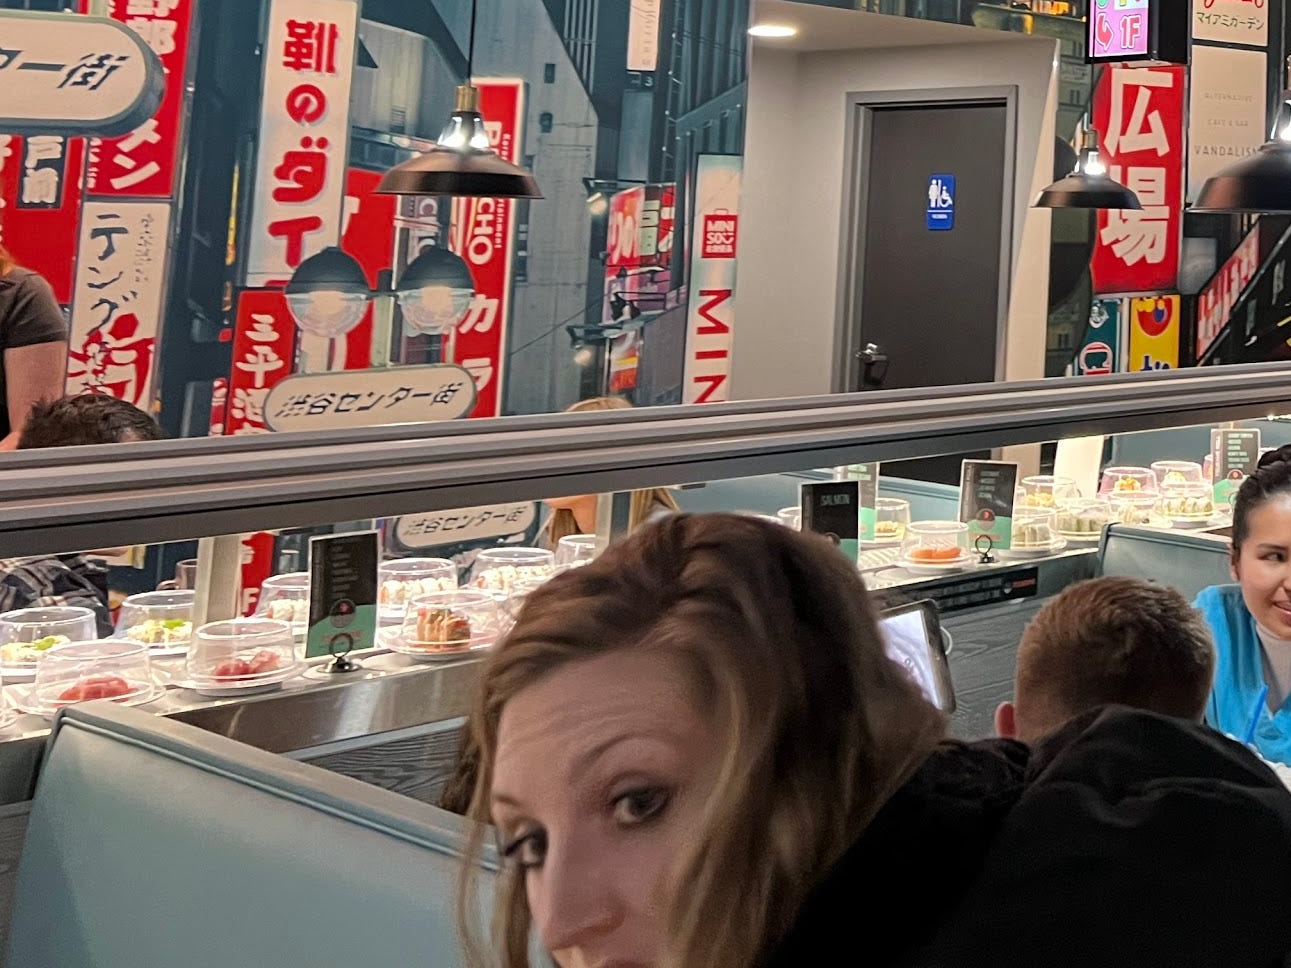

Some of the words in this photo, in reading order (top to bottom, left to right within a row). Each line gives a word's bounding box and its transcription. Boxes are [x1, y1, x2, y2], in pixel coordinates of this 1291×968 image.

[1119, 14, 1141, 49] 1F
[264, 18, 340, 287] 靴のダイ
[1100, 68, 1174, 266] 広場
[468, 197, 496, 265] CHO
[231, 313, 284, 433] 三平酒
[274, 382, 464, 418] 渋谷センター街
